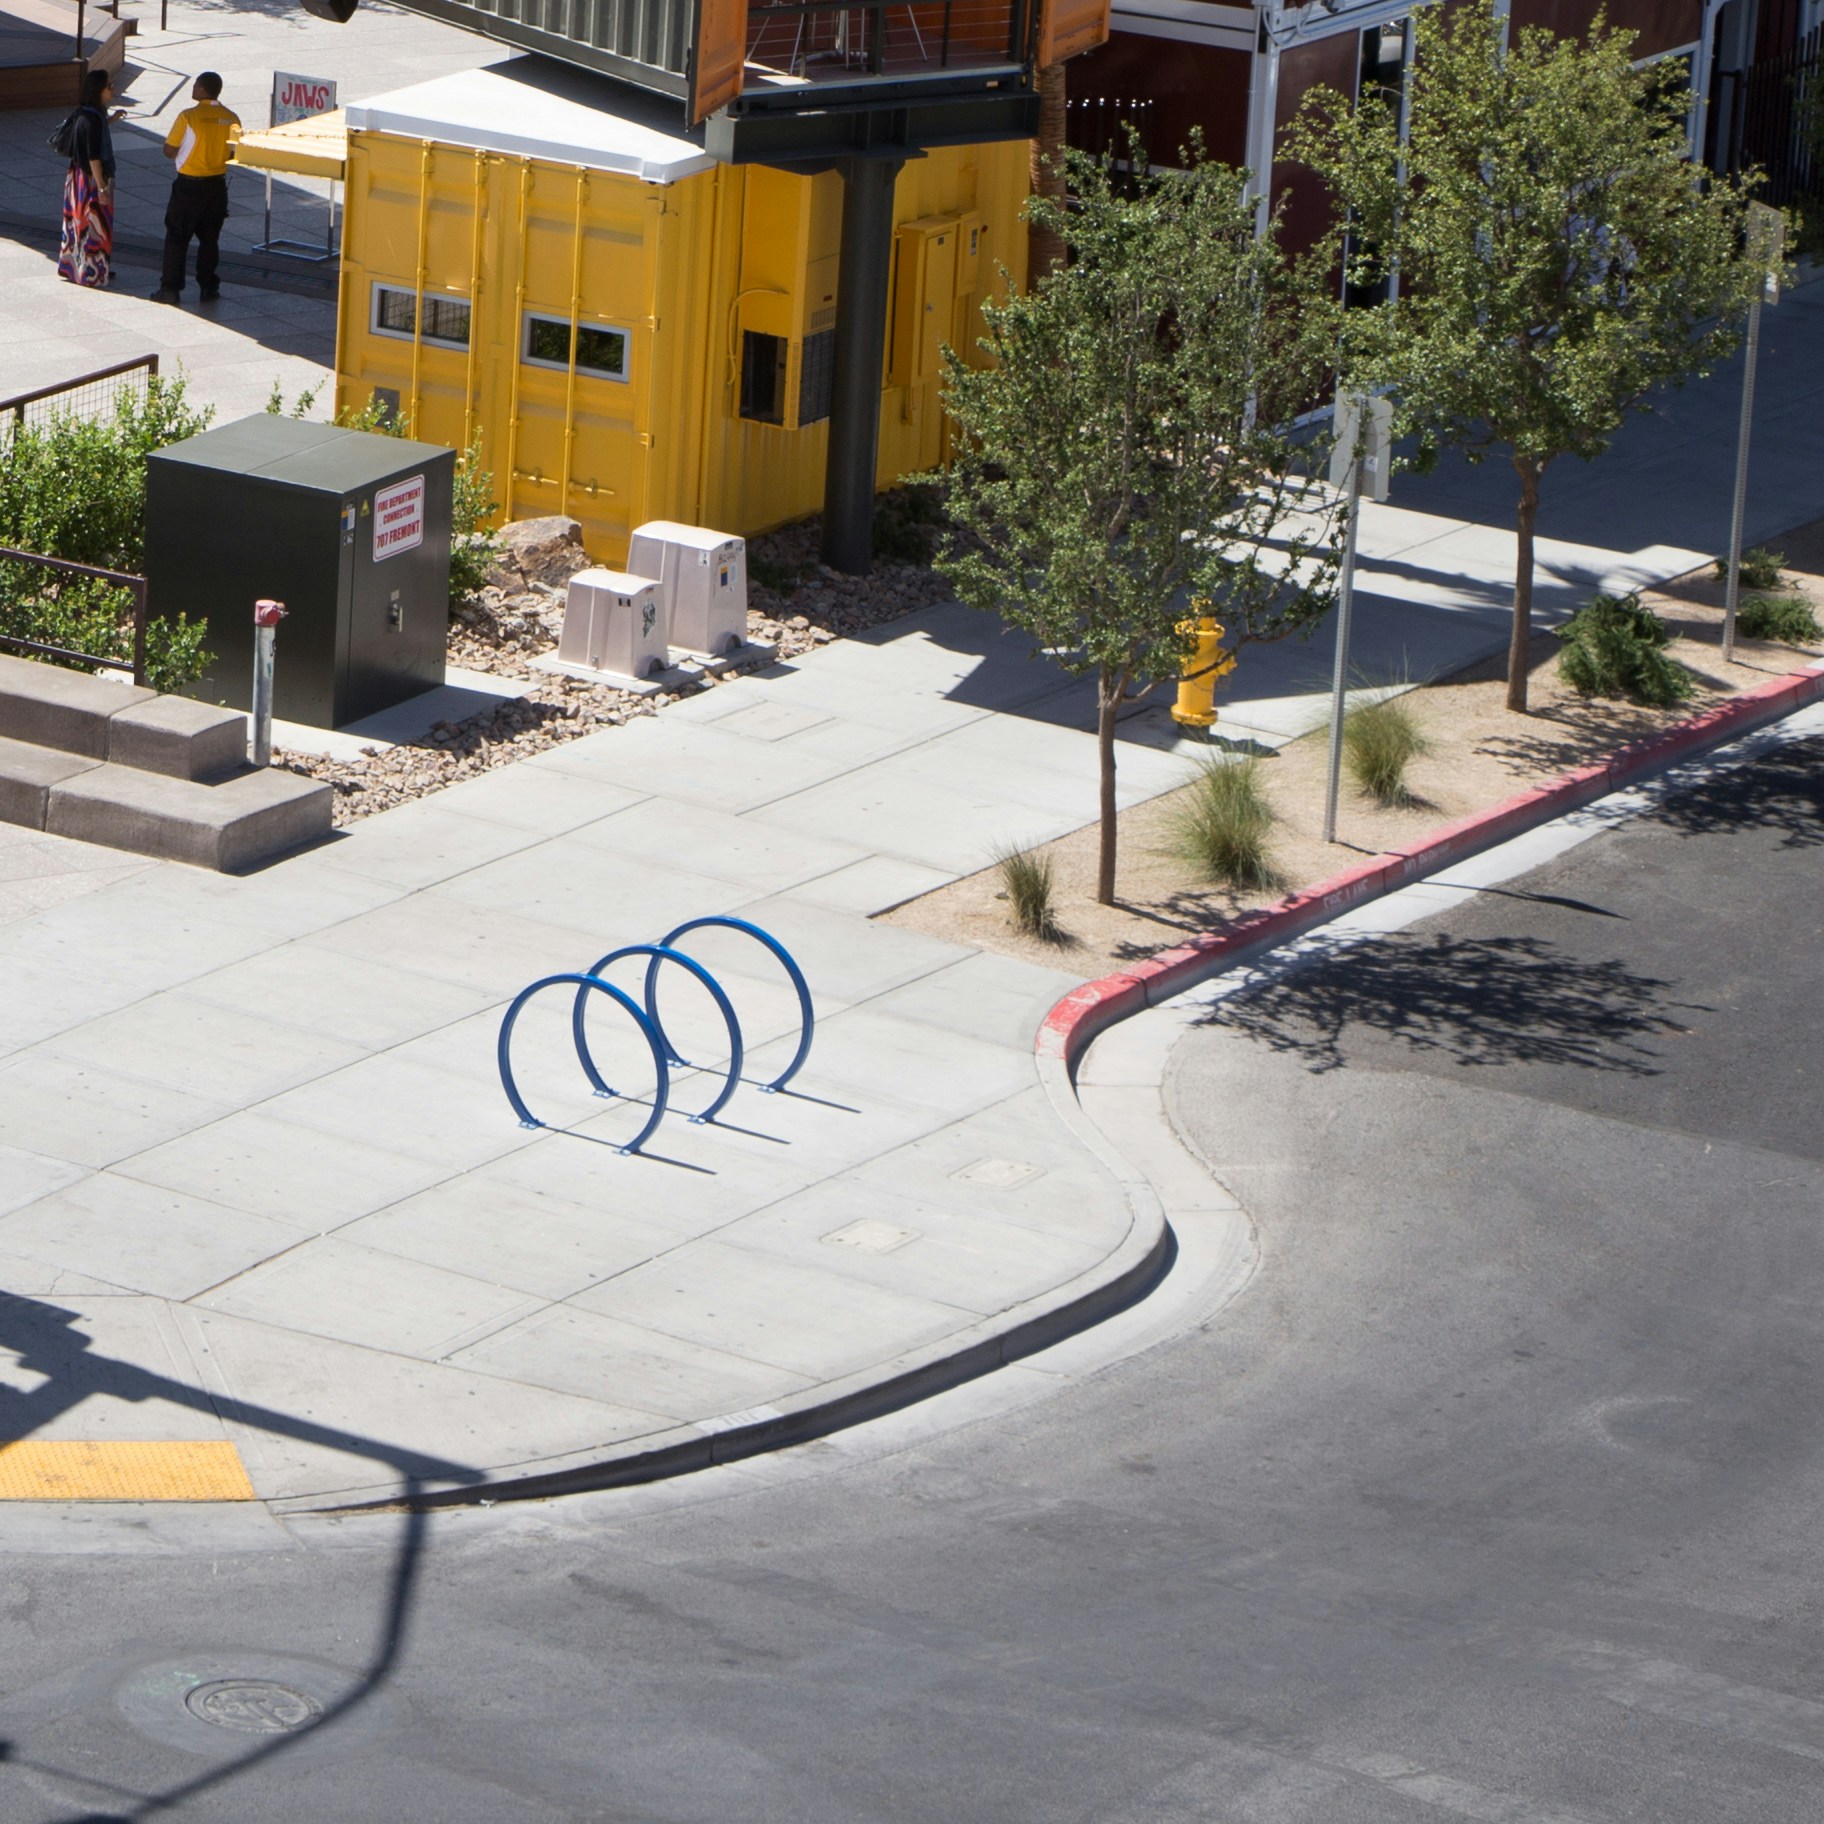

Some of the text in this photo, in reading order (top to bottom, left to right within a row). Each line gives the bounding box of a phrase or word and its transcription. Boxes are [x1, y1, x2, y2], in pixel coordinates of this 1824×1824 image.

[281, 81, 330, 111] JAWS
[376, 520, 421, 549] 707 FREMONT
